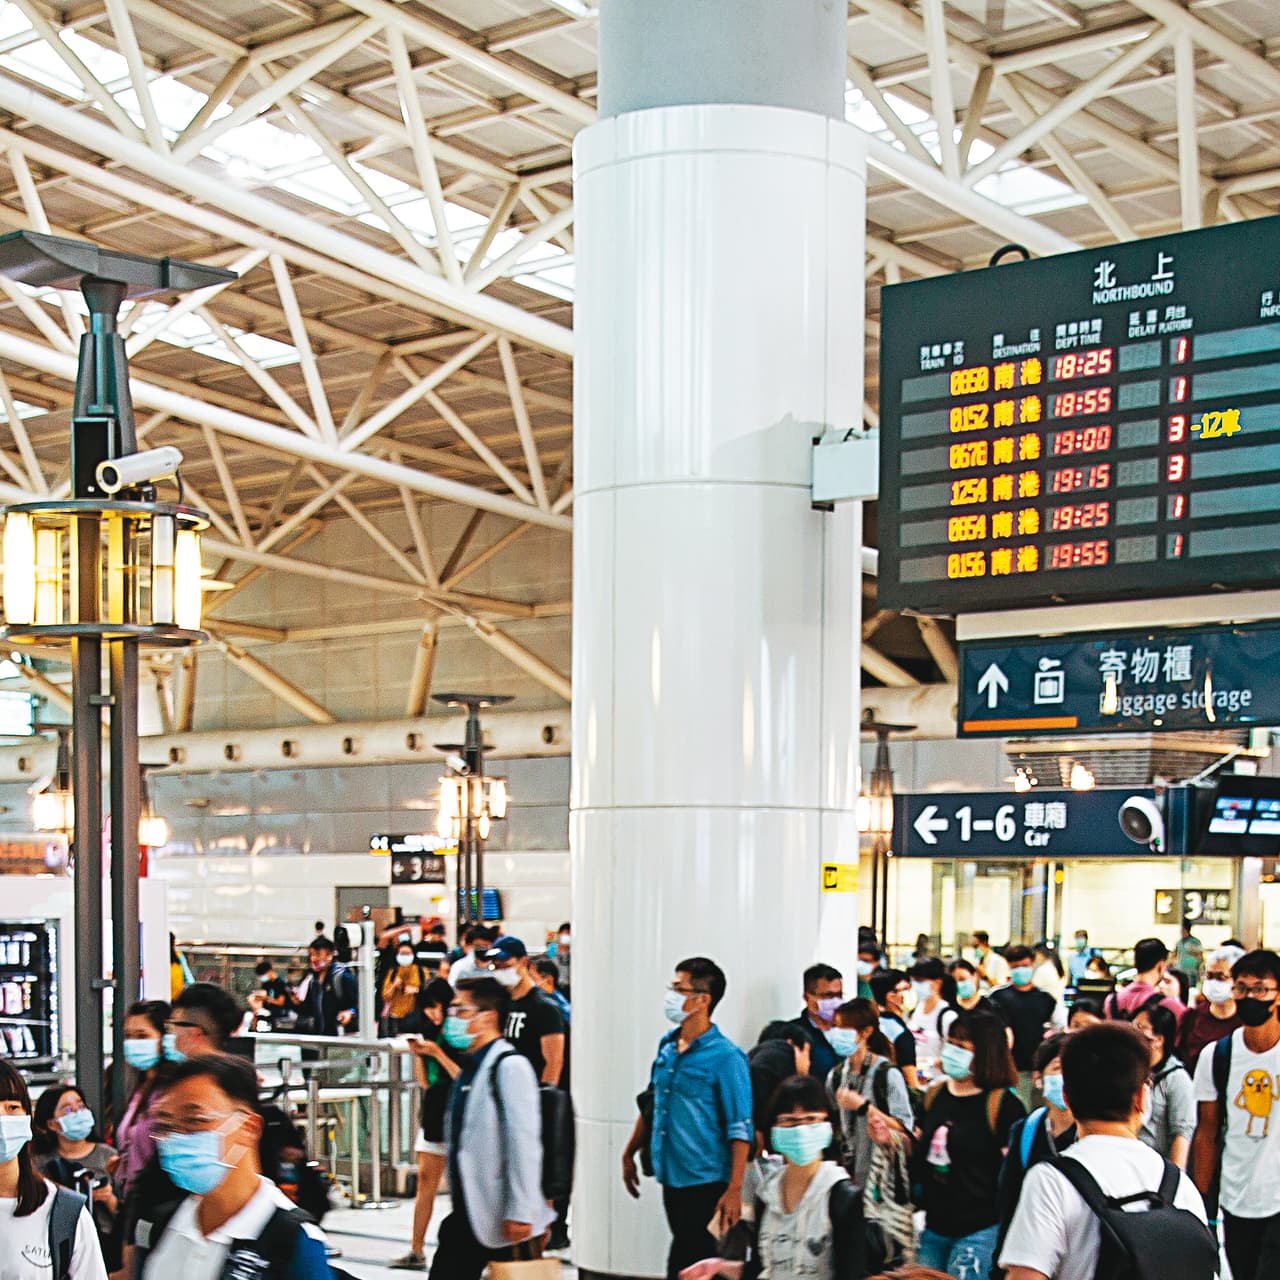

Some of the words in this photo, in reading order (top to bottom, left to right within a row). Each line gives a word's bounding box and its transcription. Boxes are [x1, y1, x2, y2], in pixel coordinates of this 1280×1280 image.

[1092, 279, 1175, 305] NORTHBOUND
[1080, 332, 1102, 346] TIME
[1128, 322, 1157, 338] DELAY
[1054, 348, 1112, 379] 18:25
[1177, 336, 1188, 363] 1
[950, 403, 989, 433] 0152
[1054, 387, 1112, 418] 18:55
[1176, 376, 1187, 402] 1
[1053, 425, 1112, 455] 19:00
[1168, 415, 1187, 443] 3
[950, 477, 987, 506] 1254
[1053, 463, 1111, 493] 19:15
[1168, 453, 1185, 482] 3
[1052, 502, 1110, 531] 19:25
[1174, 494, 1185, 519] 1
[947, 551, 986, 579] 0156
[1051, 539, 1109, 569] 19:55
[1173, 533, 1184, 557] 1
[1098, 645, 1193, 685] 寄物櫃
[955, 805, 1016, 842] 1-6
[1024, 802, 1068, 830] 車廂
[1024, 830, 1051, 848] Car
[1184, 891, 1202, 920] 3
